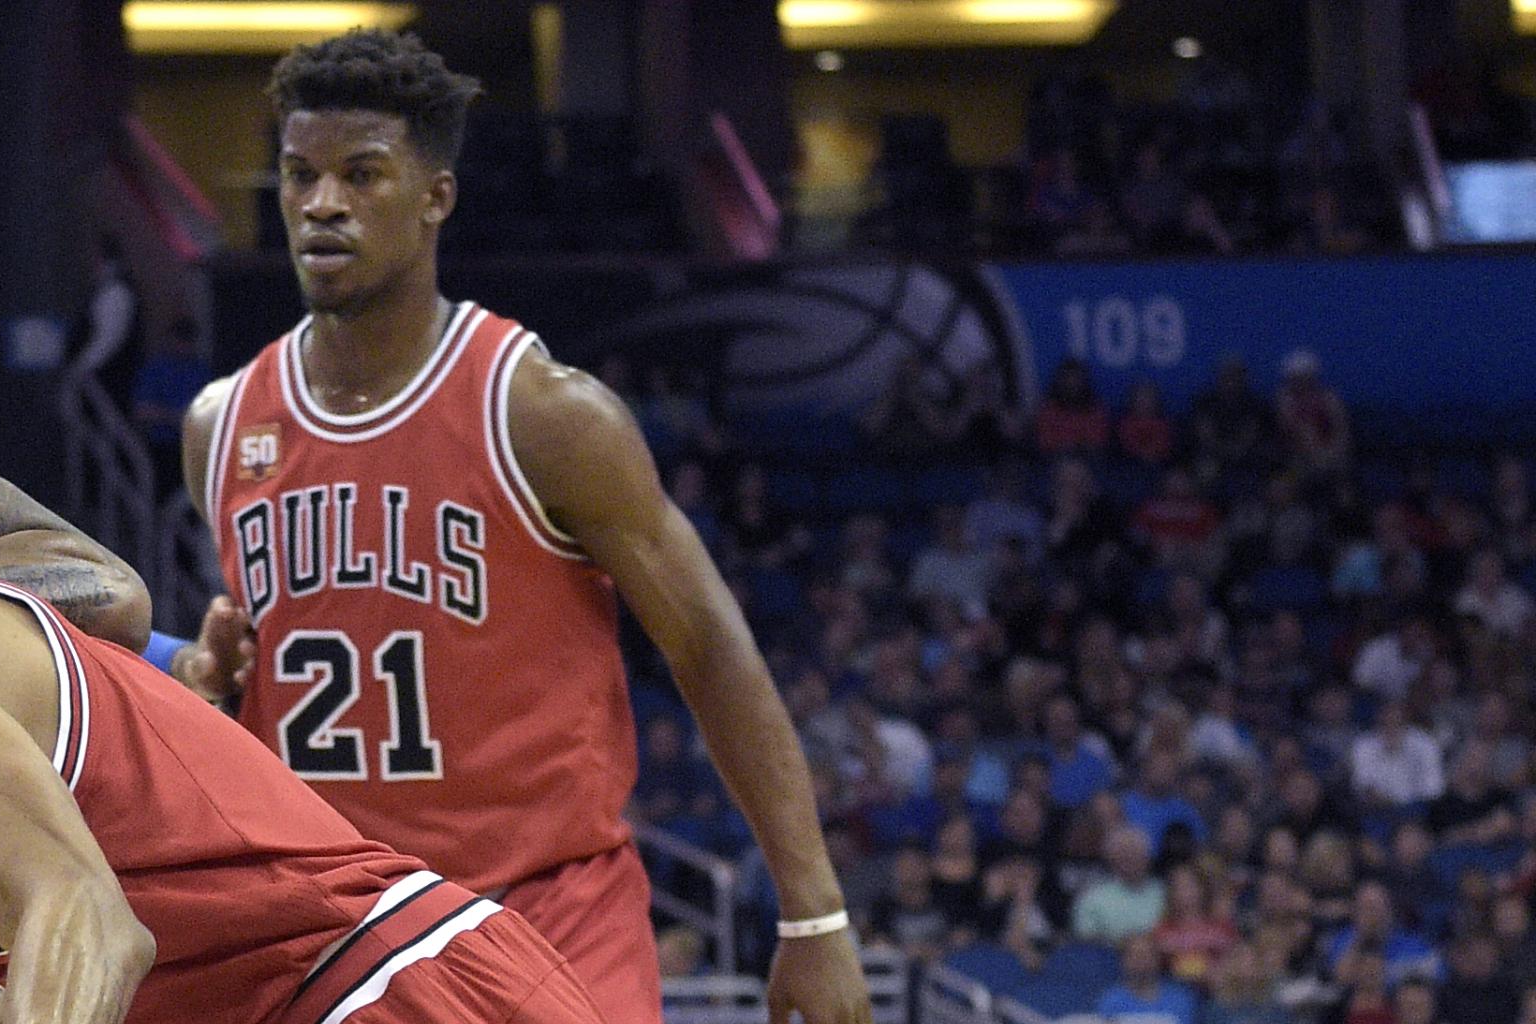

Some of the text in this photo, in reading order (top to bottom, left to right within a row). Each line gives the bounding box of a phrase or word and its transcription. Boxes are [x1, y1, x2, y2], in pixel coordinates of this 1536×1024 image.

[1065, 295, 1185, 366] 109
[240, 434, 277, 467] 50
[233, 482, 487, 626] BULLS
[274, 629, 443, 782] 21
